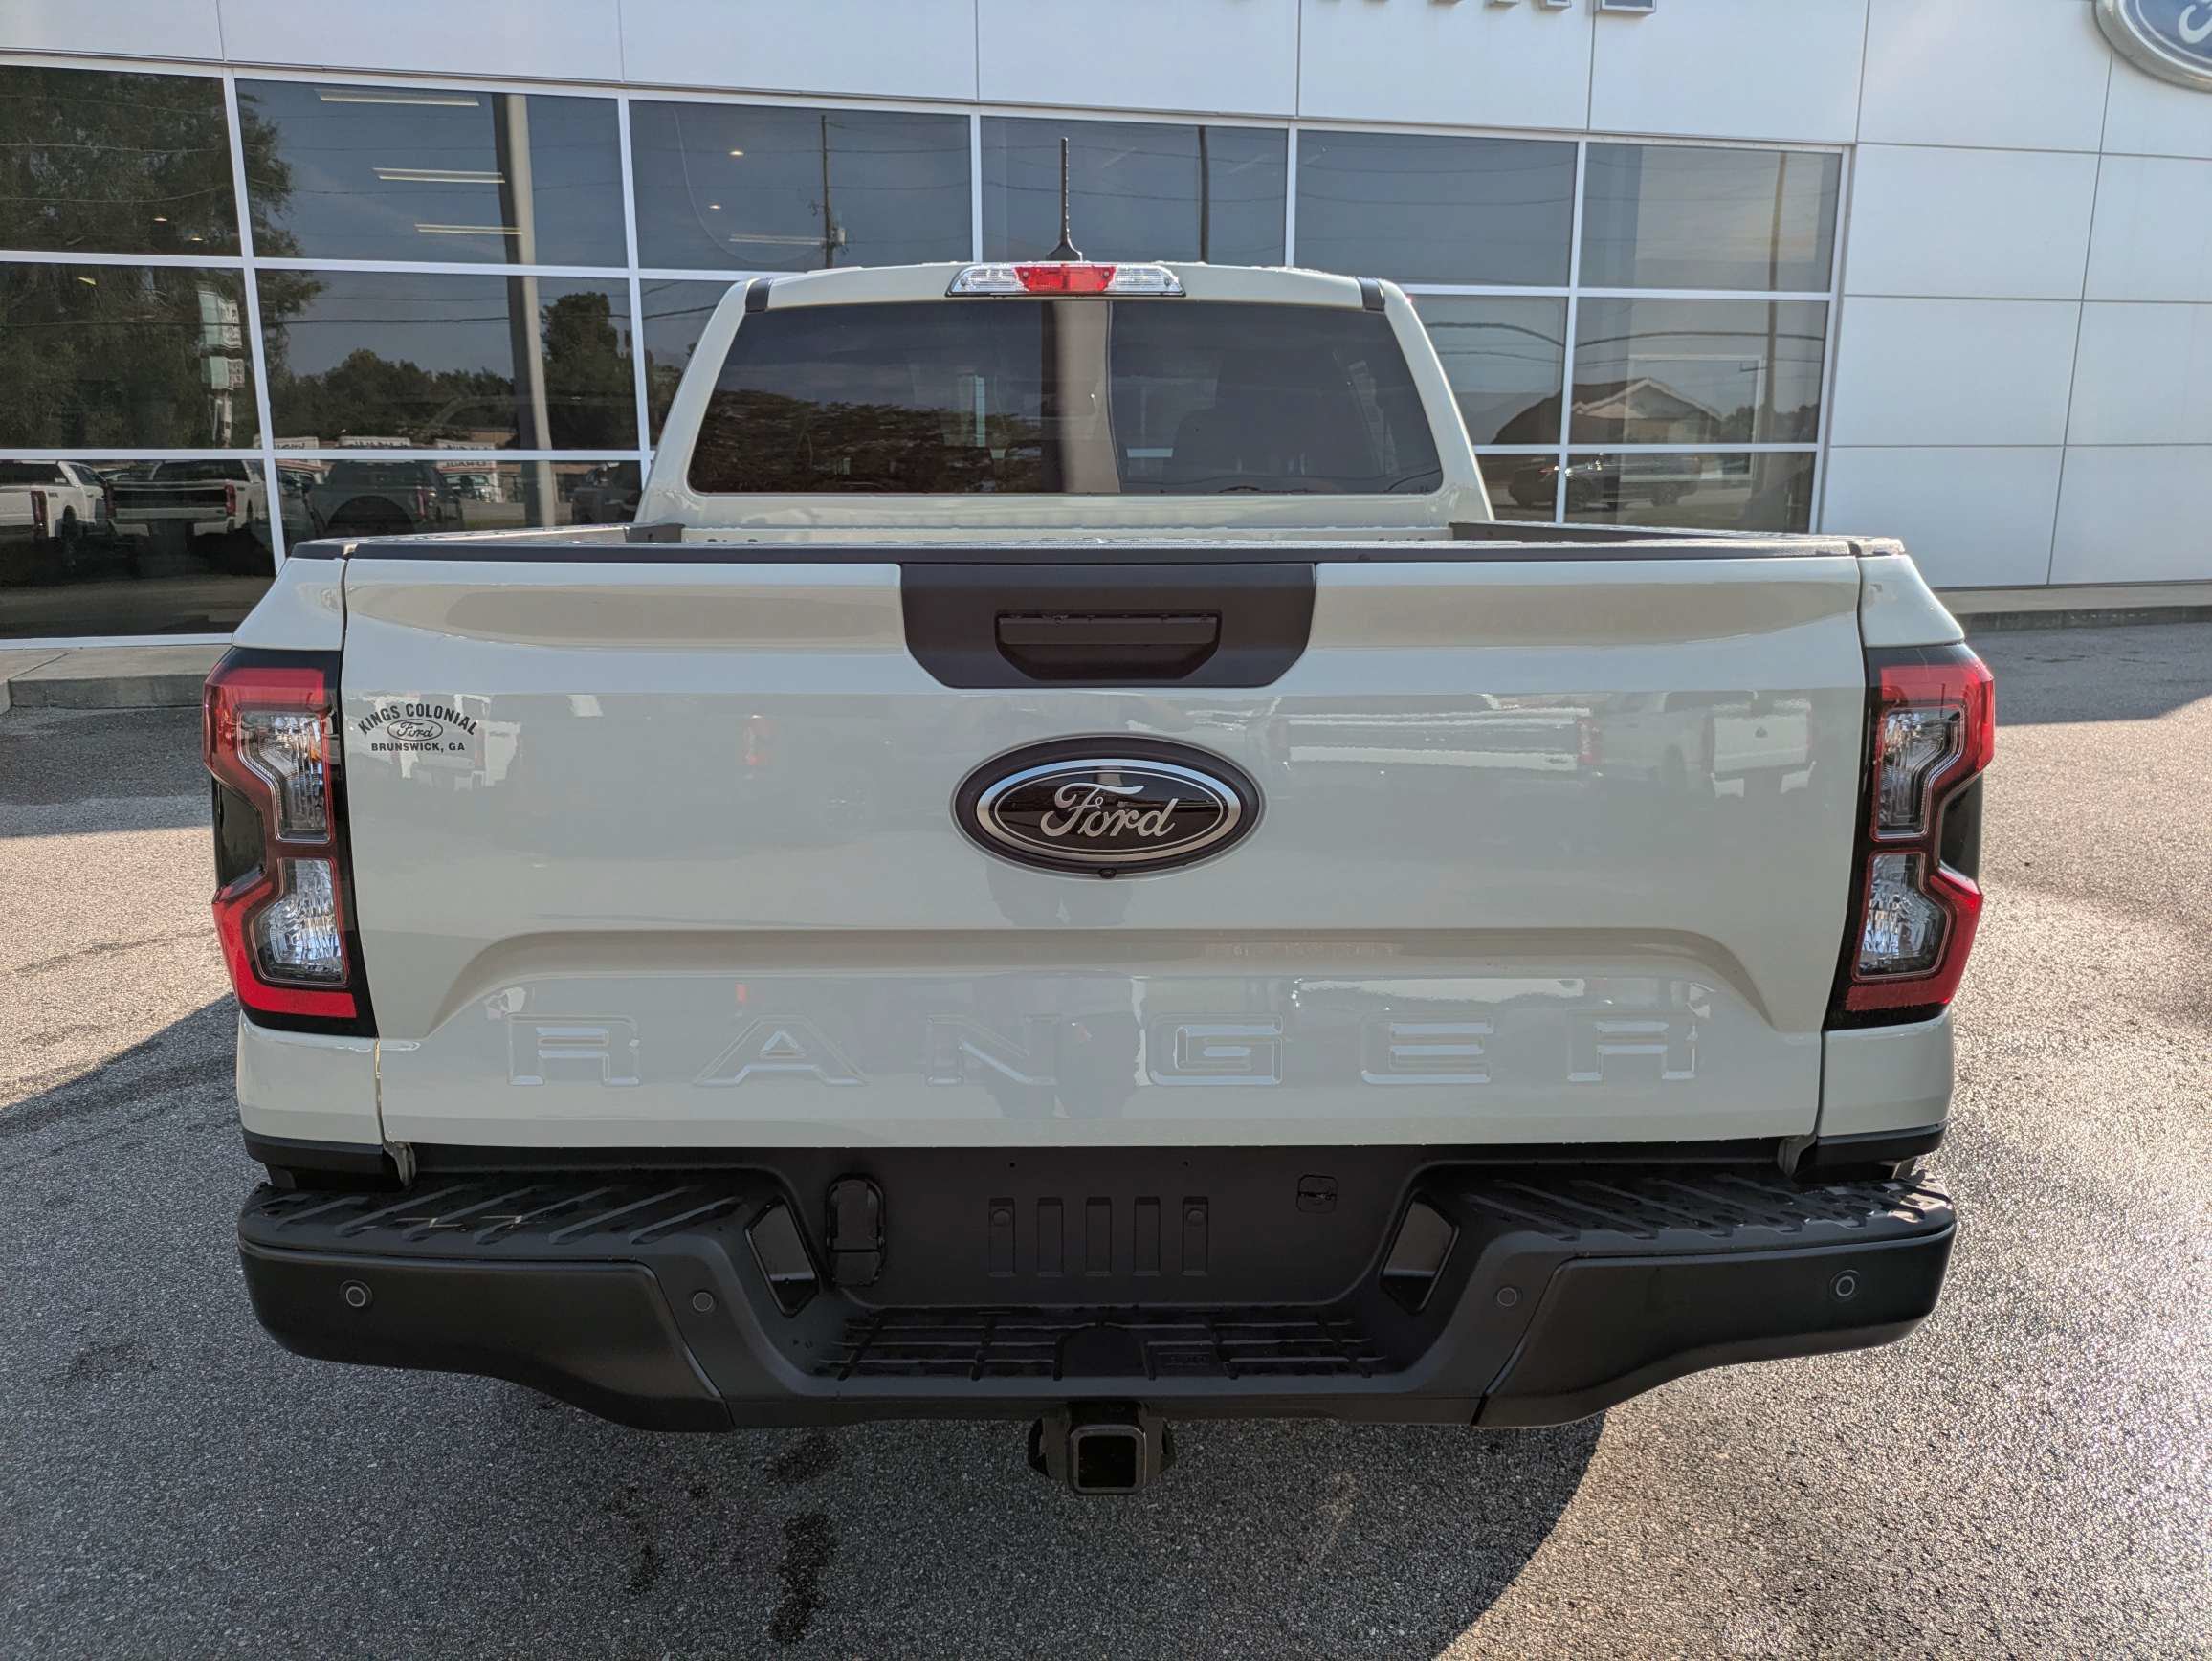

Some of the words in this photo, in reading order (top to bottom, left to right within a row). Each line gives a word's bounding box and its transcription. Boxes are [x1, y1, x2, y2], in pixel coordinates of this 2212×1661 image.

[358, 705, 400, 735] KINGS
[405, 703, 478, 735] COLONIAL
[396, 720, 434, 738] Ford
[371, 742, 444, 753] BRUNSWICK,
[448, 742, 465, 751] GA
[1039, 782, 1179, 837] Ford
[506, 1012, 1696, 1087] RANGER
